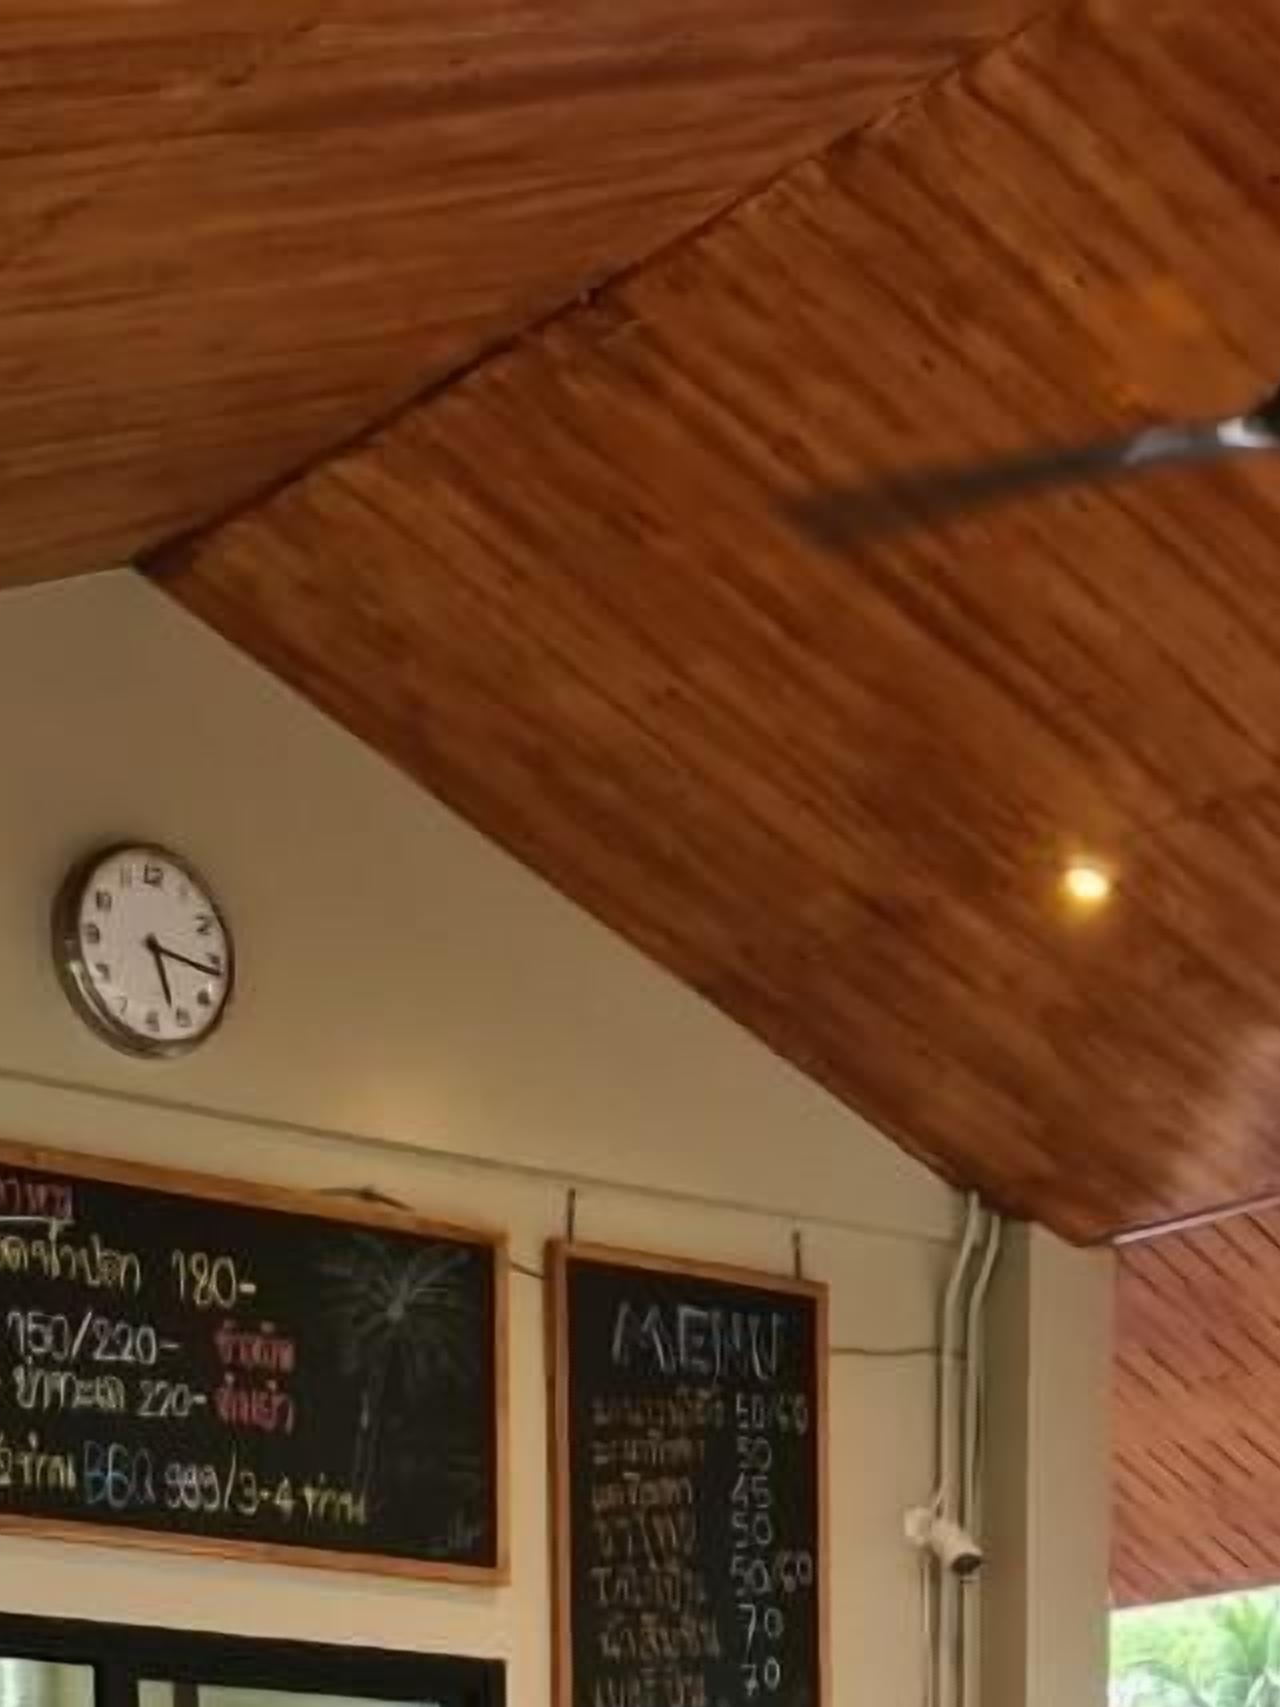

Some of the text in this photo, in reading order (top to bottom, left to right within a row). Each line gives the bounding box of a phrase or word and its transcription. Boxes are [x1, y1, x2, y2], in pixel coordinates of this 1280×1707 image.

[612, 1300, 786, 1388] MENU
[83, 1440, 157, 1509] BBQ
[729, 1472, 773, 1510] 45
[730, 1510, 774, 1550] 50
[736, 1604, 784, 1657] 70
[740, 1655, 781, 1697] 70
